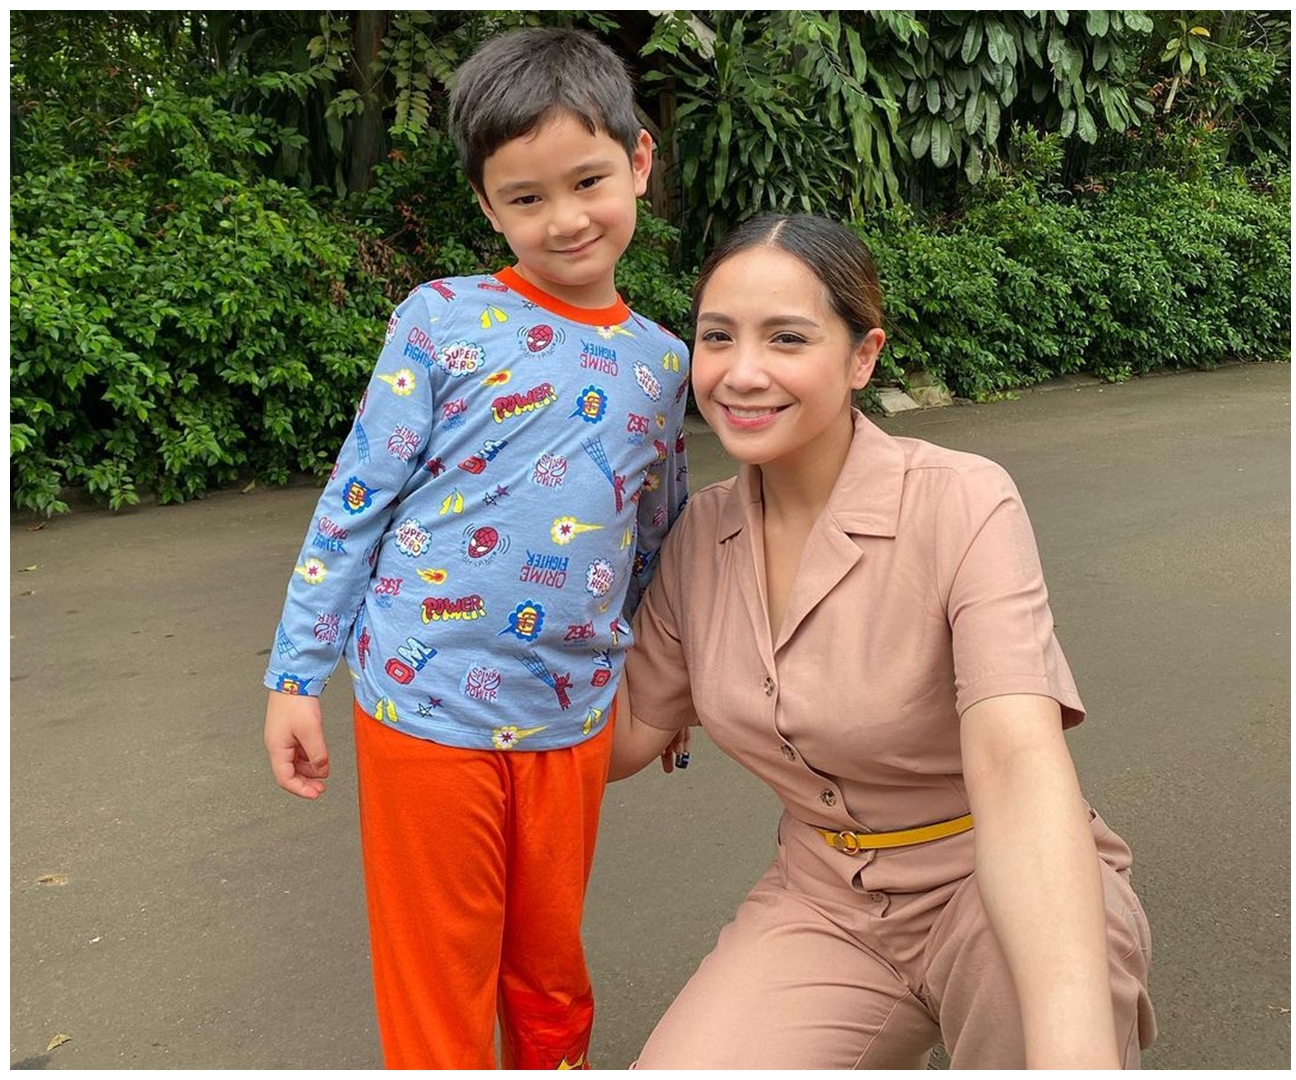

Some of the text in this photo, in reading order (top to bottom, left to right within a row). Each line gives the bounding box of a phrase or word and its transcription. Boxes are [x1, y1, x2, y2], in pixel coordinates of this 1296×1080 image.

[408, 326, 439, 361] CRIME
[443, 347, 479, 362] SUPER
[580, 339, 617, 361] FIGHTER
[448, 360, 476, 371] HERO
[580, 353, 619, 377] CRIME
[490, 382, 558, 424] POWER
[532, 472, 563, 487] POWER
[317, 516, 348, 540] CRIME
[398, 534, 420, 553] HERO
[526, 549, 569, 571] FIGHTER
[519, 566, 567, 589] CRIME
[421, 594, 487, 625] POWER
[465, 685, 498, 700] POWER
